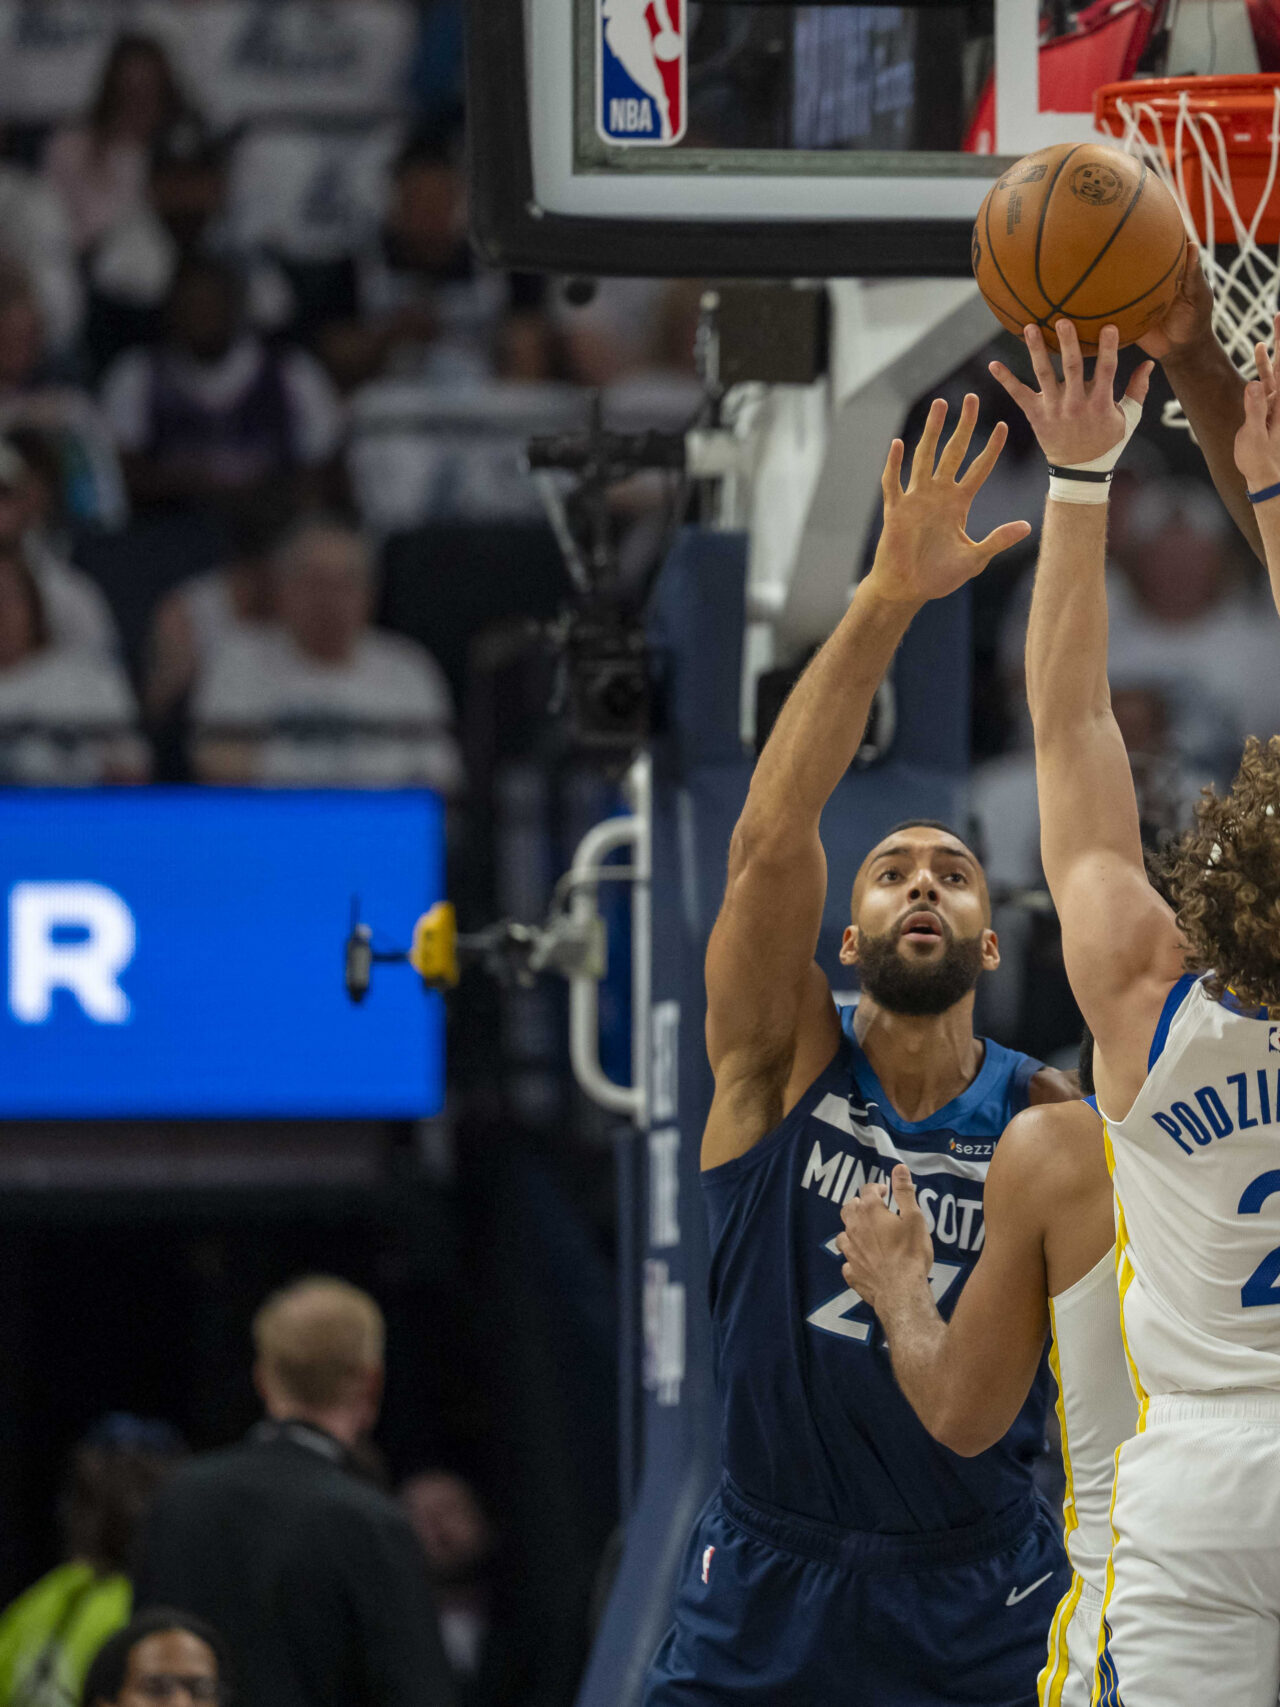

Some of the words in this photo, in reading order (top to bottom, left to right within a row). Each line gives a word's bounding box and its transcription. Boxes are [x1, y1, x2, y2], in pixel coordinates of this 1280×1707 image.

[609, 98, 653, 132] NBA
[10, 880, 136, 1023] R
[955, 1140, 997, 1155] sezzl
